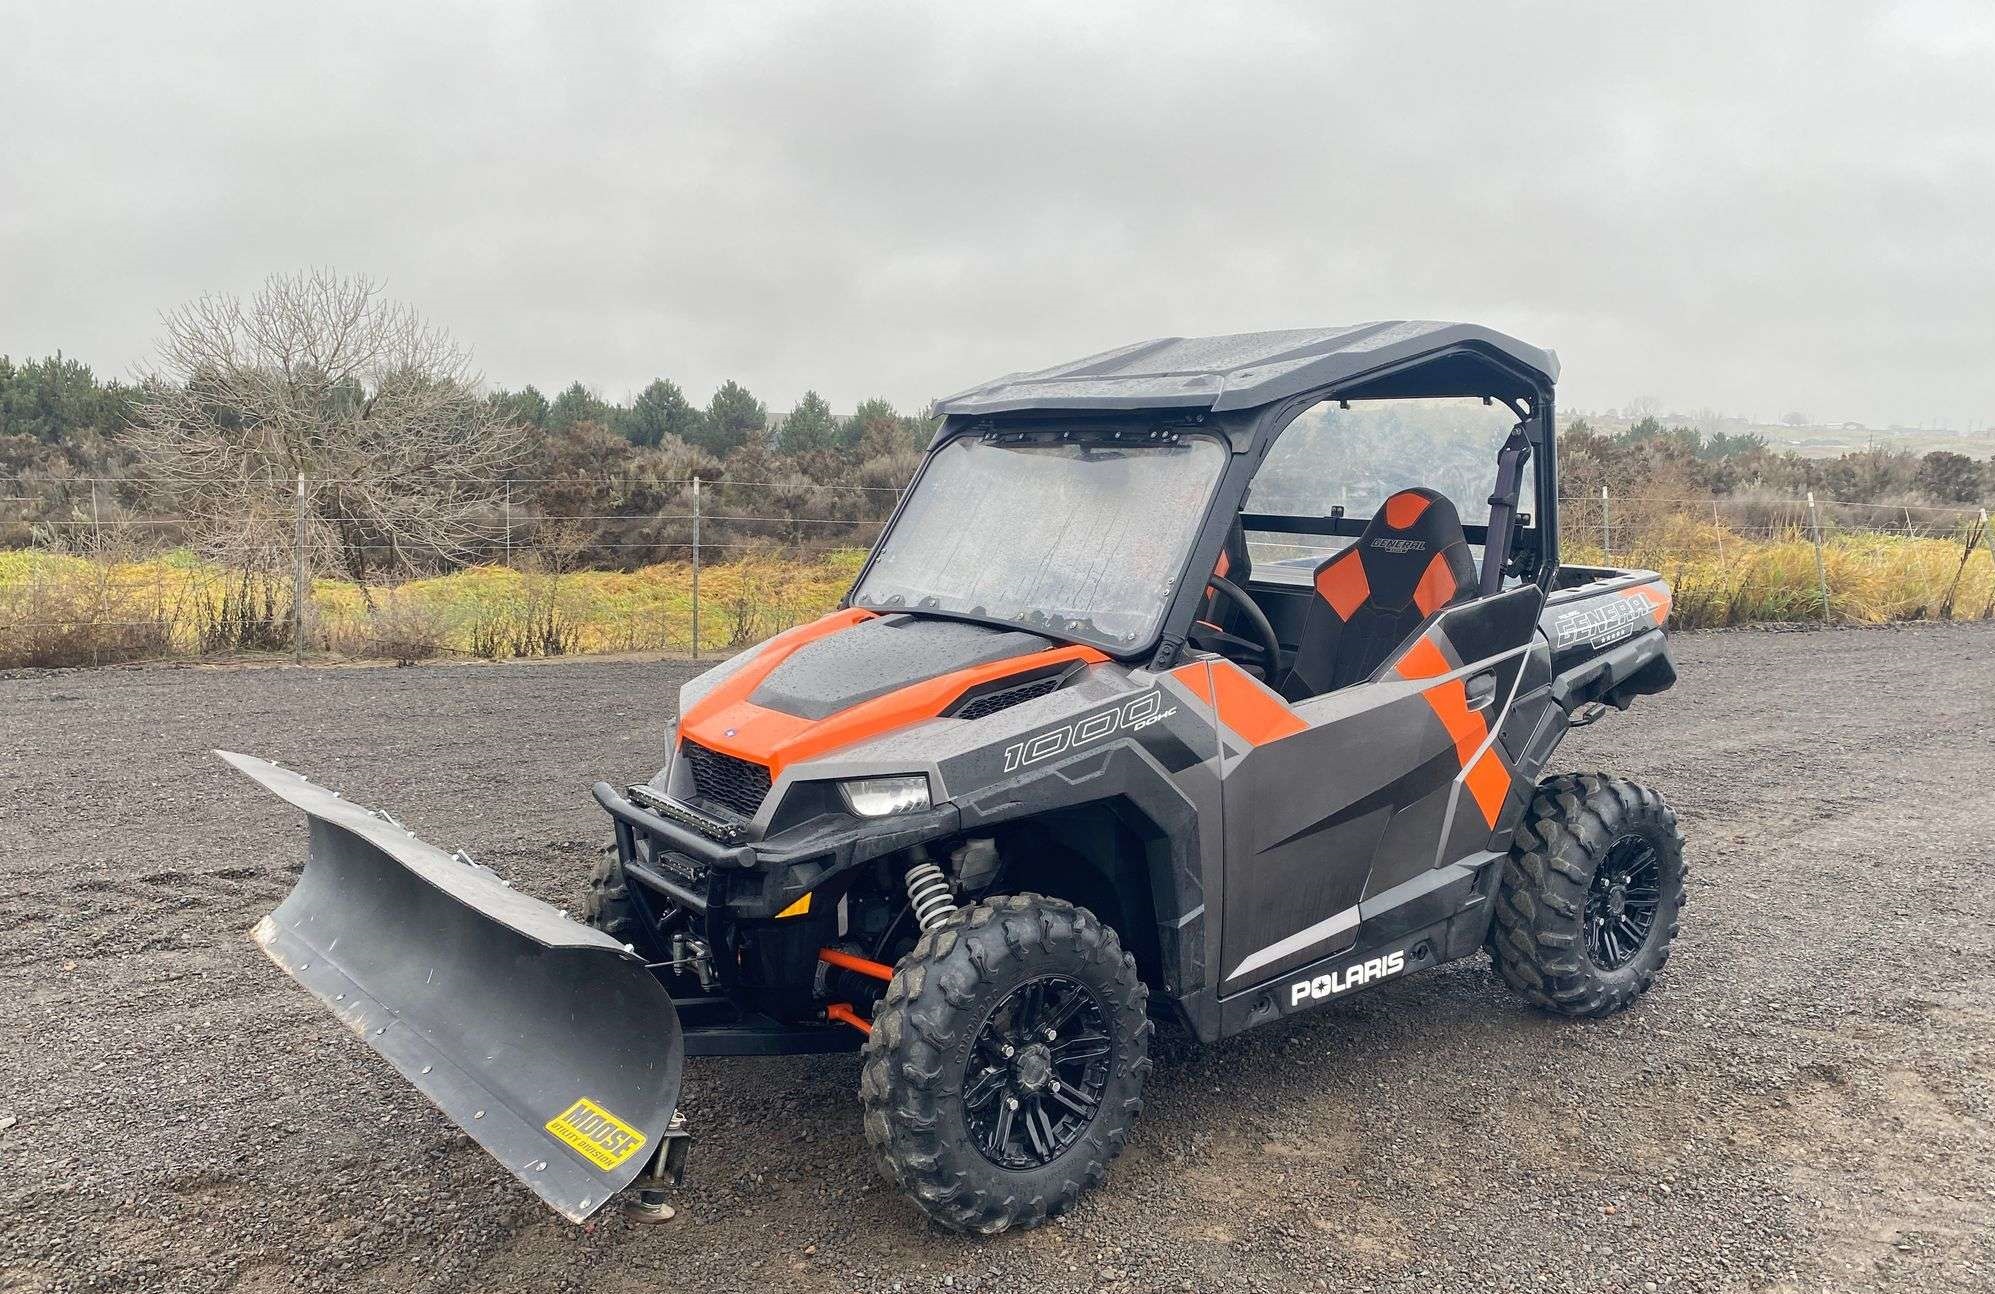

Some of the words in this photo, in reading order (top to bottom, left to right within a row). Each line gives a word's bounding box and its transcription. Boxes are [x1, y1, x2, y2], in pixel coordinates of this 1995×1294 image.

[1370, 538, 1426, 551] GENERAL
[1554, 592, 1659, 648] GENERAL
[1004, 690, 1162, 773] 1000
[1133, 706, 1177, 732] DOHC
[1291, 949, 1405, 1007] POLARIS
[551, 1121, 580, 1143] UTILITY
[577, 1140, 616, 1167] DIVISION
[562, 1104, 640, 1158] MOOSE
